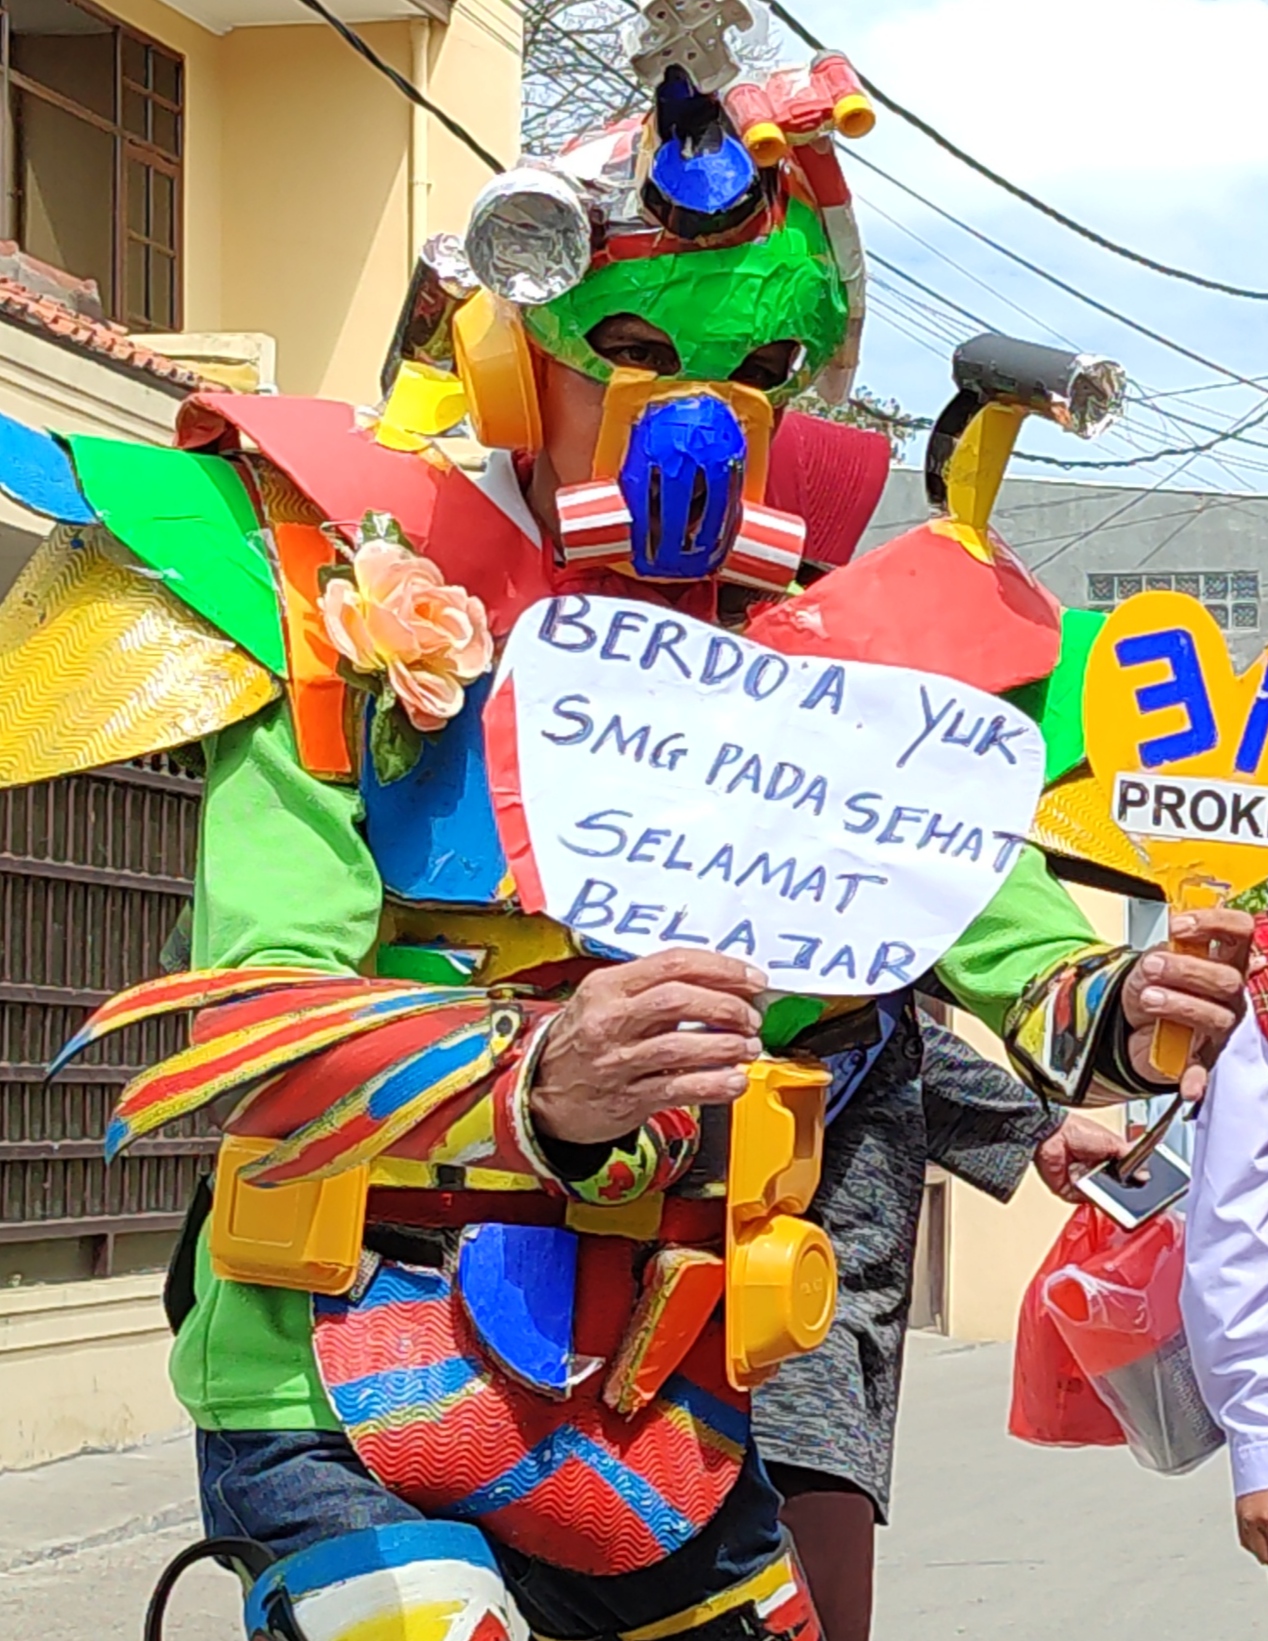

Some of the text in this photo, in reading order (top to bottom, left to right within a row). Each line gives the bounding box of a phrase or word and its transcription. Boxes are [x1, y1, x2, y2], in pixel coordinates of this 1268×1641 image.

[896, 685, 1030, 768] YUK
[541, 693, 1025, 873] SMG PADA SEHAT
[557, 808, 889, 914] SELAMAT
[566, 878, 917, 986] BELAJAR
